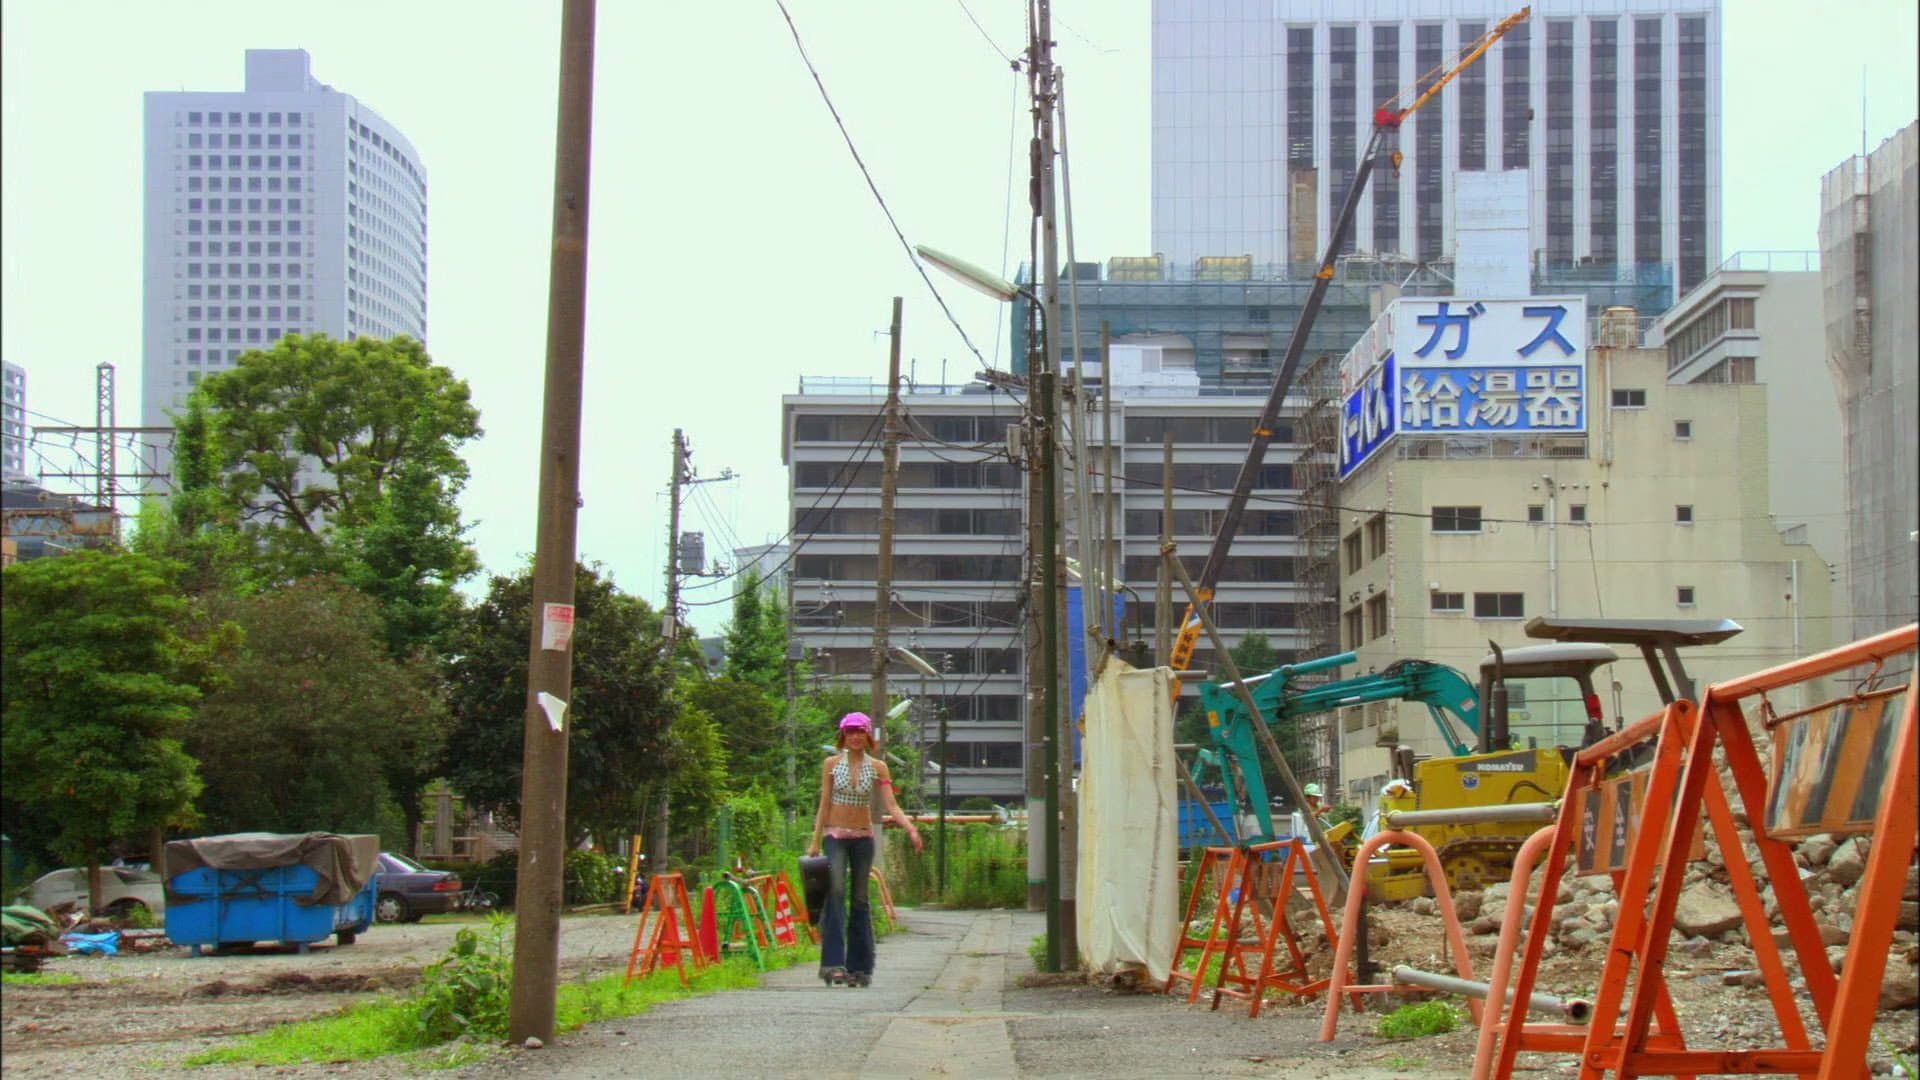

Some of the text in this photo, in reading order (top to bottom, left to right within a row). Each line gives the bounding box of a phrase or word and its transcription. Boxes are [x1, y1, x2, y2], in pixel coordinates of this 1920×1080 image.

[1414, 301, 1576, 360] ガス
[1402, 370, 1582, 428] 給湯器
[1477, 762, 1524, 772] KOMATSU
